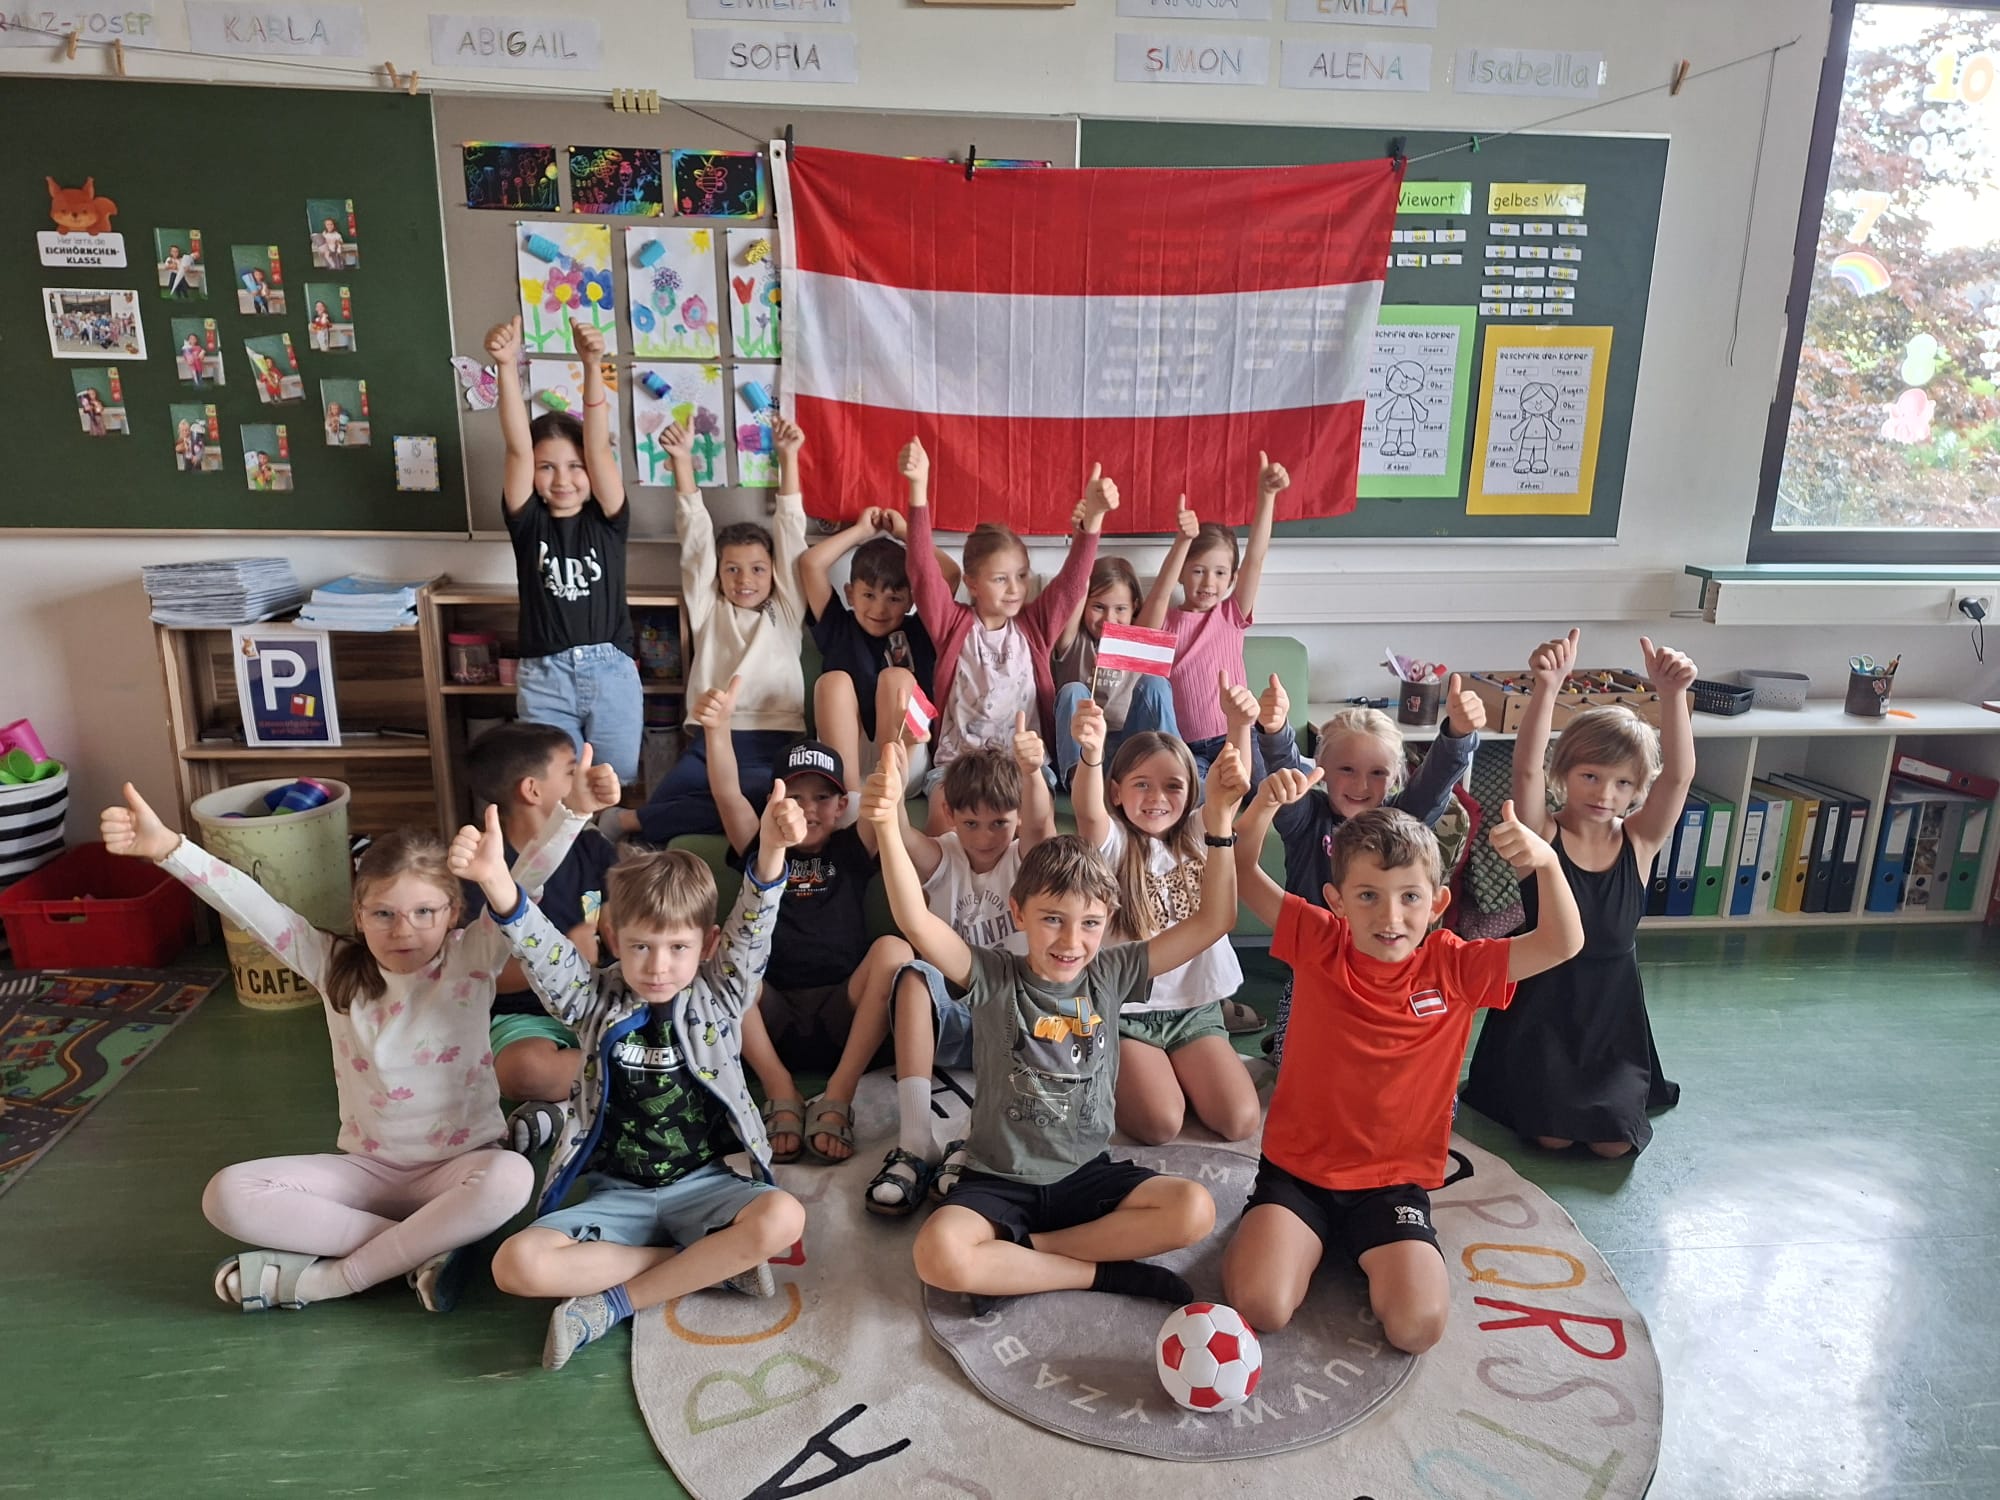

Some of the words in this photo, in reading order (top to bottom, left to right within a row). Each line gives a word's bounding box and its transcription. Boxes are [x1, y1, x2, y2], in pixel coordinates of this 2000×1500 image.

[223, 14, 330, 45] KARLA
[458, 27, 578, 60] ABIGAIL
[730, 42, 821, 71] SOFIA
[1145, 46, 1242, 75] SIMON
[1309, 52, 1404, 80] ALENA
[1469, 51, 1590, 89] Isabella
[1494, 191, 1539, 211] gelbes
[66, 256, 102, 265] KLASSE
[260, 649, 307, 711] P
[788, 750, 834, 773] AUSTRIA
[1473, 1296, 1628, 1361] R
[684, 1351, 842, 1435] B
[1476, 1355, 1637, 1427] S
[742, 1403, 912, 1500] A
[1456, 1408, 1627, 1500] T
